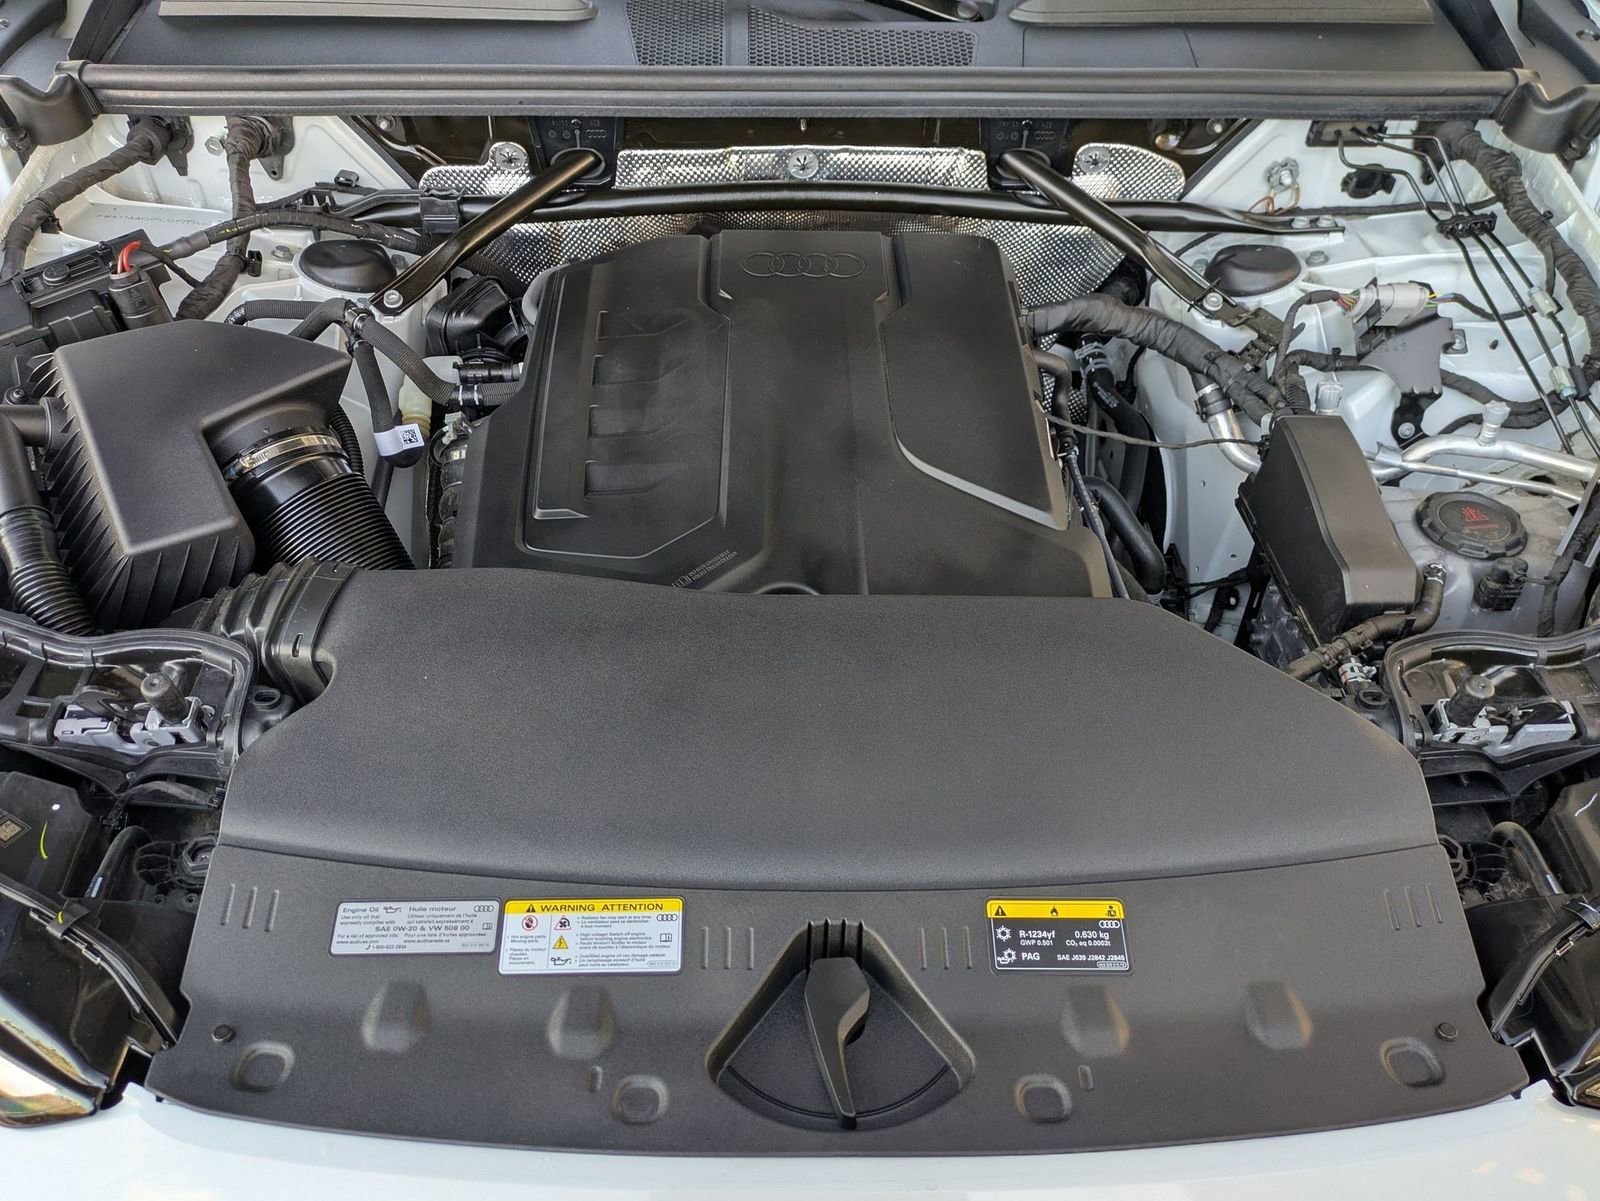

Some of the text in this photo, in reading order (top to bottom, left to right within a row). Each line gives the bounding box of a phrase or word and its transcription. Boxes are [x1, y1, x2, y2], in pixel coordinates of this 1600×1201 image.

[541, 903, 664, 912] WARNING ATTENTION
[1019, 930, 1056, 940] R-1234yf
[1074, 930, 1110, 940] 0.630 kg
[1022, 952, 1040, 960] PAG
